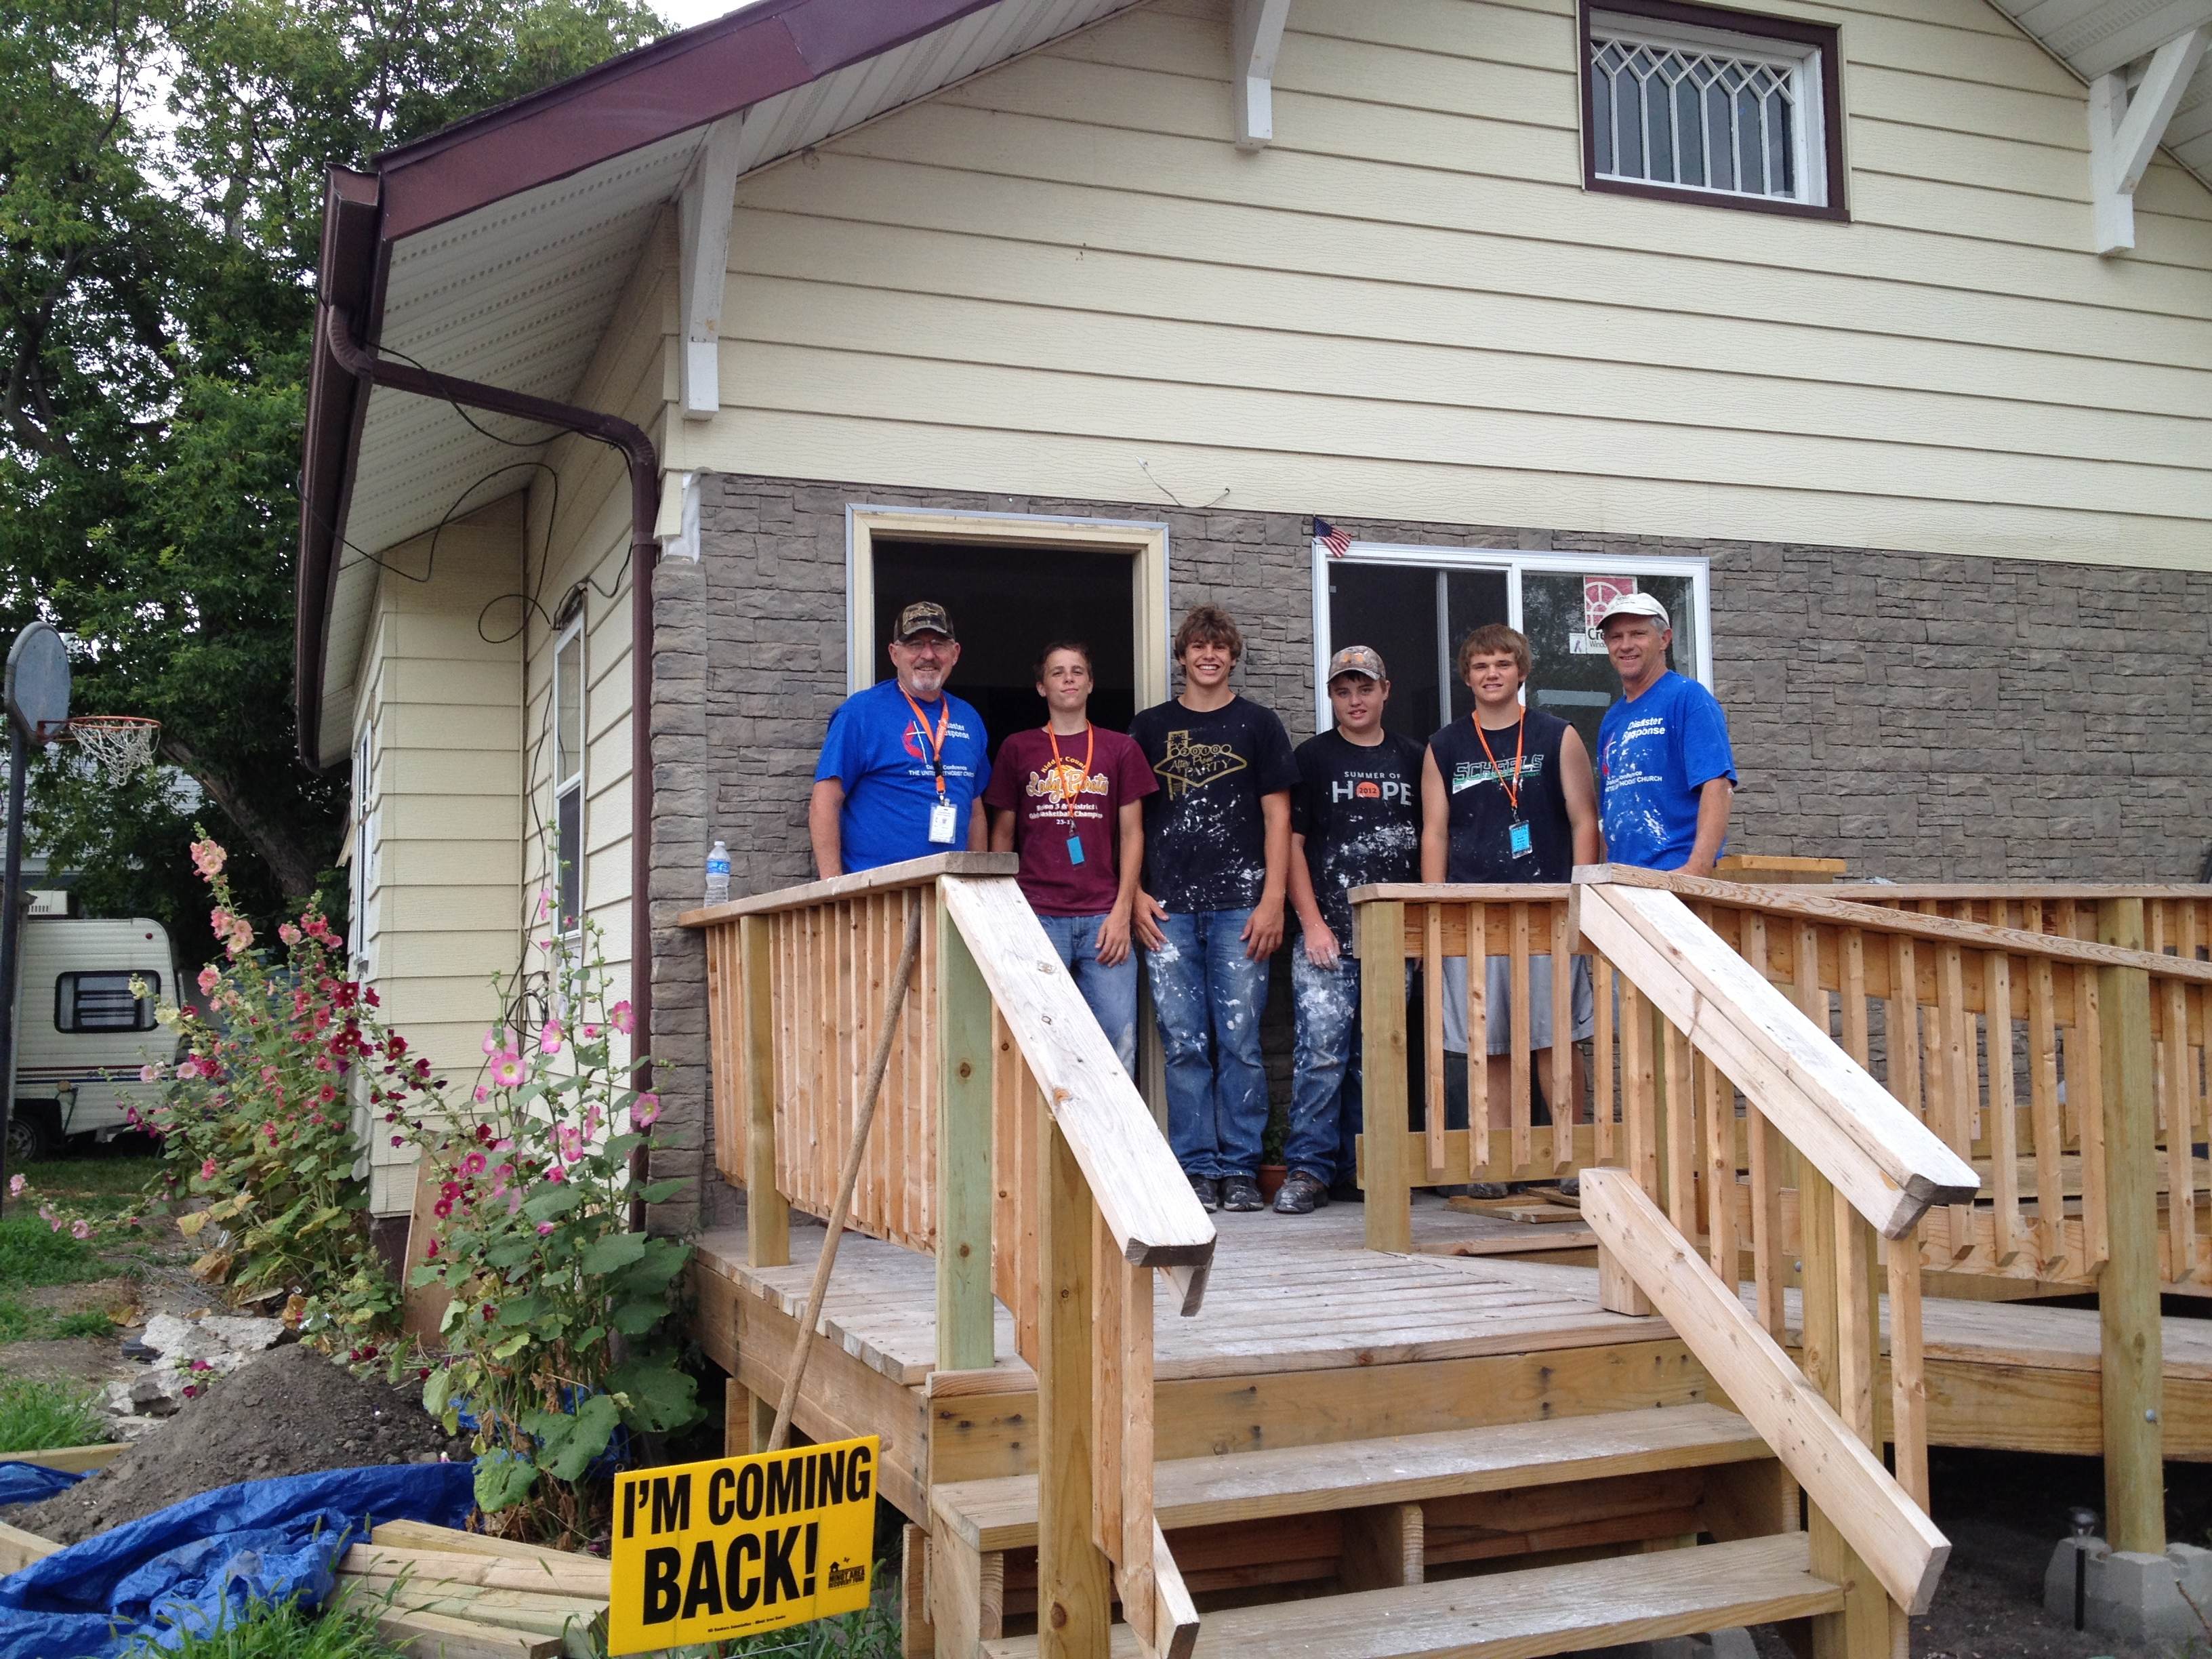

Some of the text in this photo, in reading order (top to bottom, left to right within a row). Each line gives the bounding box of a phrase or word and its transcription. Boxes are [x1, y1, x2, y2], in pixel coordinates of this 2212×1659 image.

[1627, 717, 1663, 730] Disaster
[1041, 757, 1063, 773] Kiddr
[1183, 758, 1232, 777] PARTY
[1025, 771, 1063, 804] Lady
[623, 1446, 872, 1539] I'M COMING
[642, 1521, 819, 1626] BACK!
